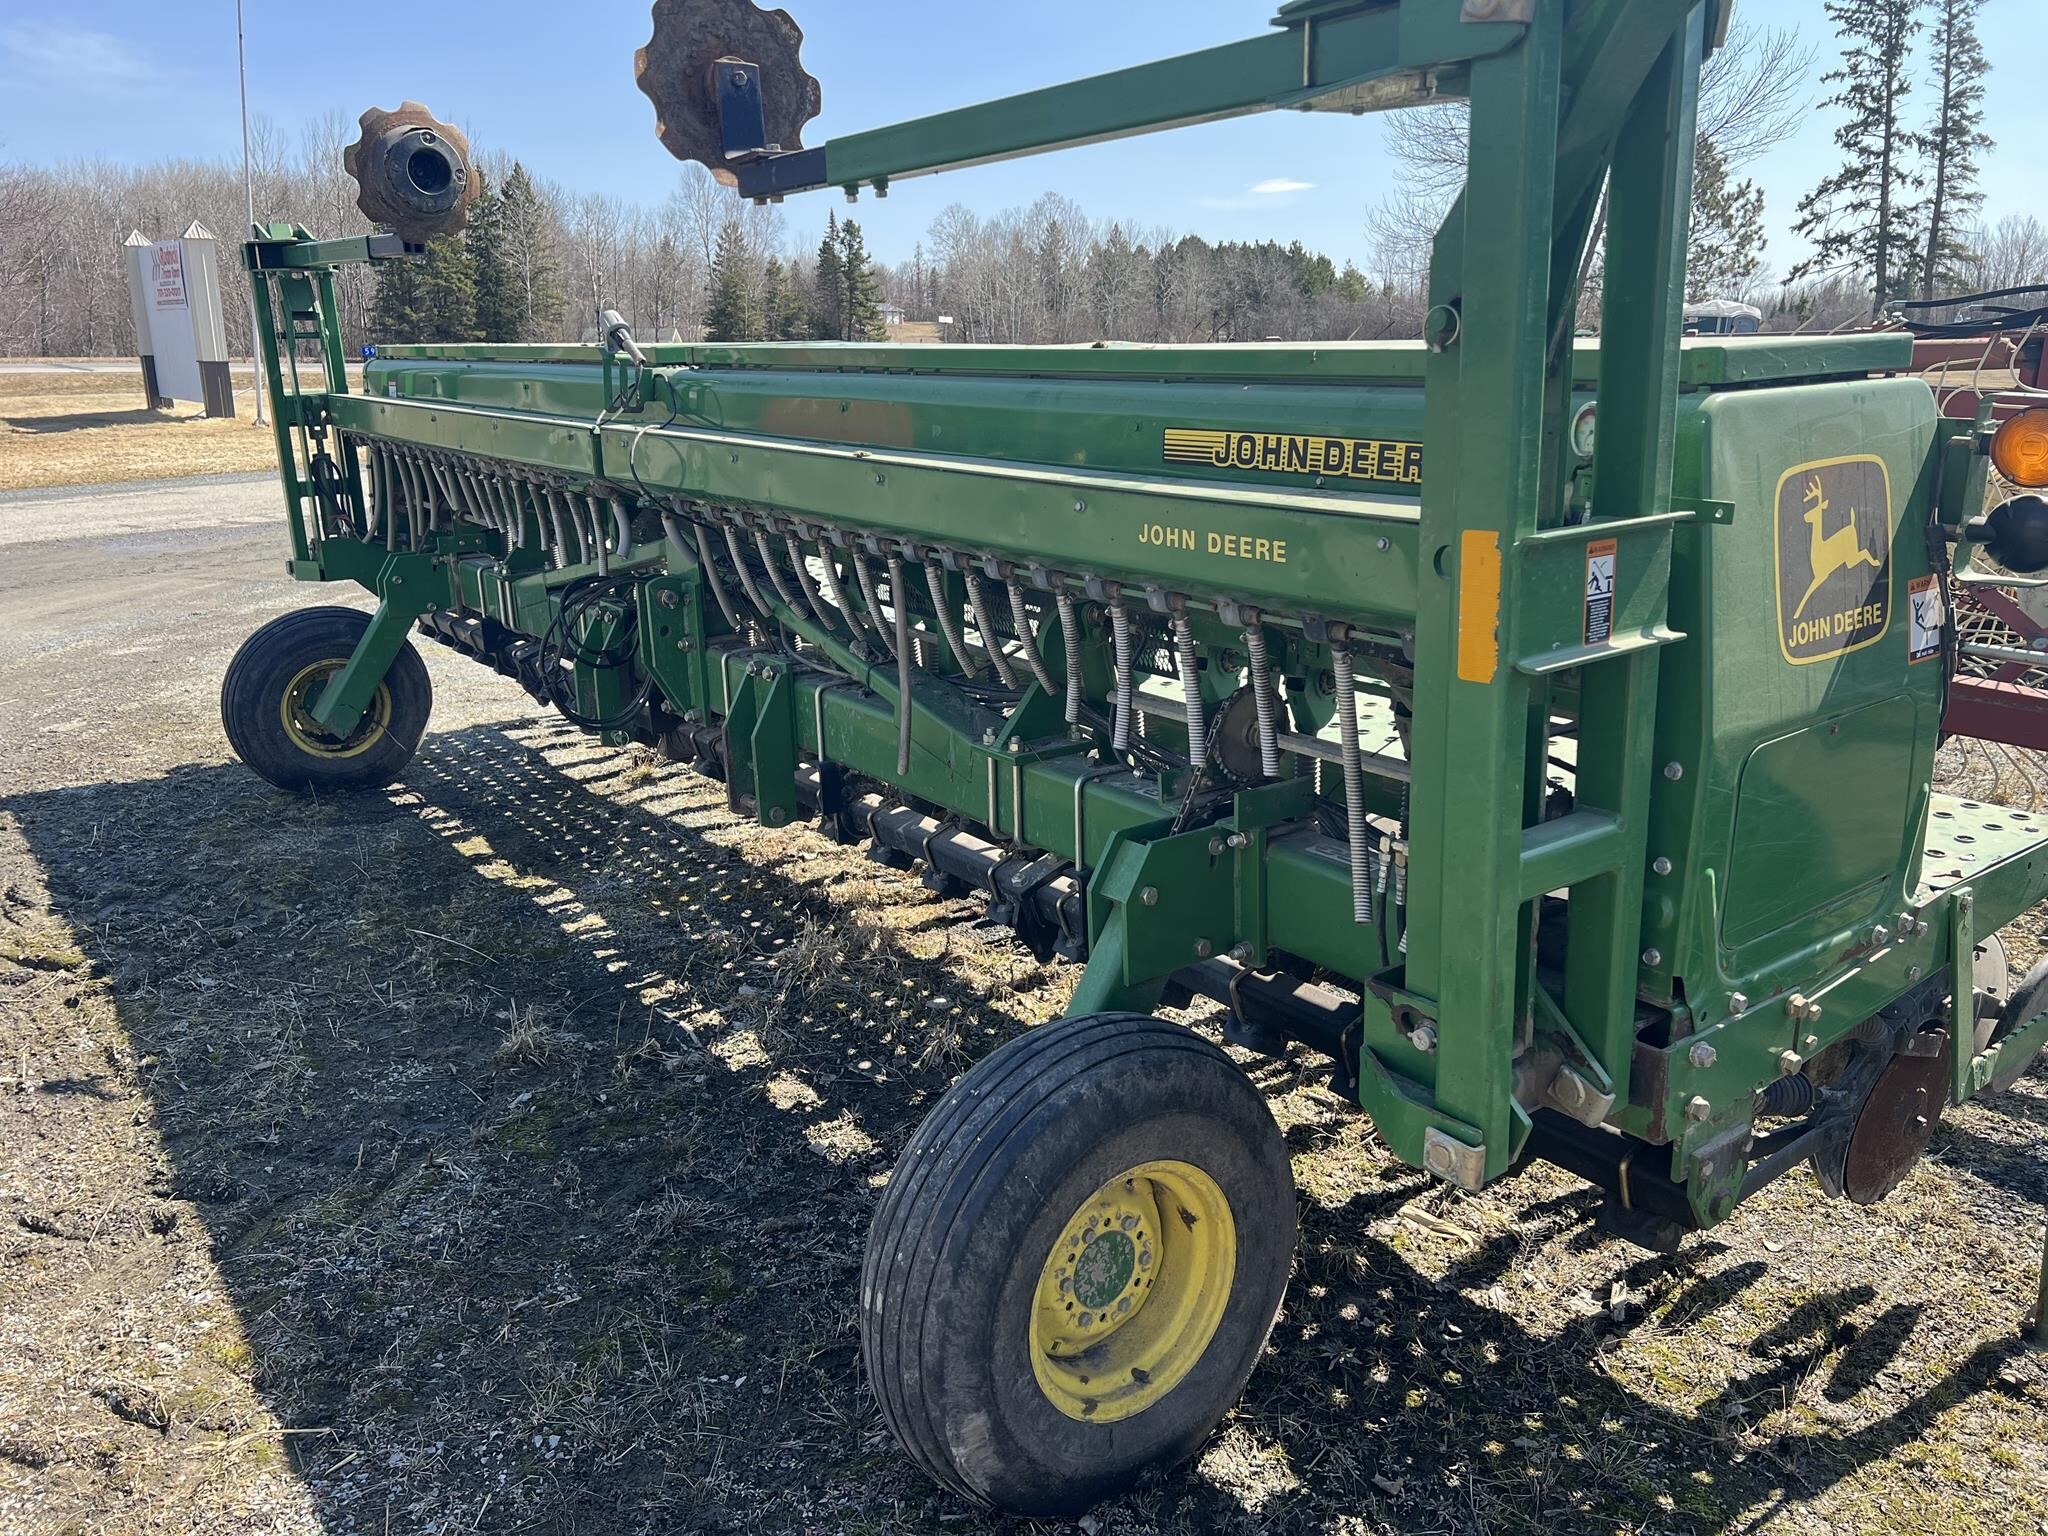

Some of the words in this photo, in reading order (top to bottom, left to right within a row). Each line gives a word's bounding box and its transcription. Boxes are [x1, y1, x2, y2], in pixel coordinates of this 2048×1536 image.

[1212, 433, 1310, 473] JOHN
[1320, 439, 1423, 484] DEER
[1138, 523, 1196, 551] JOHN
[1206, 531, 1288, 564] DEERE
[1788, 616, 1831, 648] JOHN
[1834, 602, 1882, 635] DEERE
